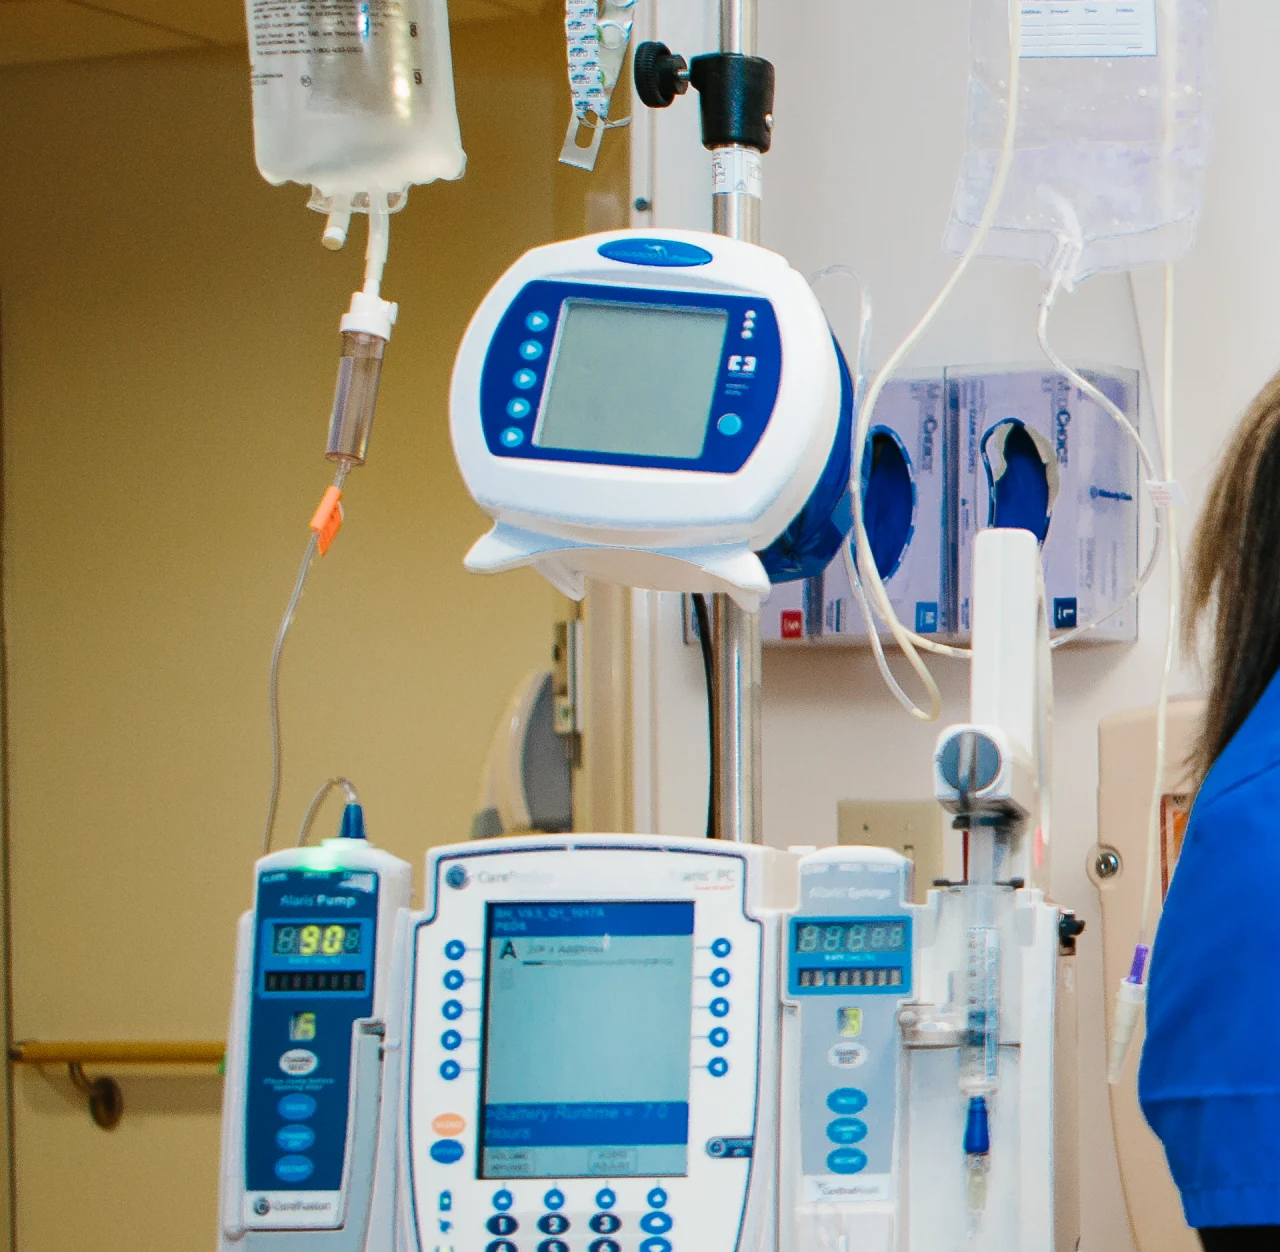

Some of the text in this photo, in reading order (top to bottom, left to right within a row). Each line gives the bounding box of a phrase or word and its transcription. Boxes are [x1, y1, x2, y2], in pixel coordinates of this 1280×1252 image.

[409, 23, 418, 38] 8
[414, 71, 422, 86] 9
[316, 894, 356, 909] Pump
[299, 924, 346, 957] 90
[500, 940, 517, 960] A
[548, 1217, 561, 1233] 2
[599, 1216, 612, 1232] 3
